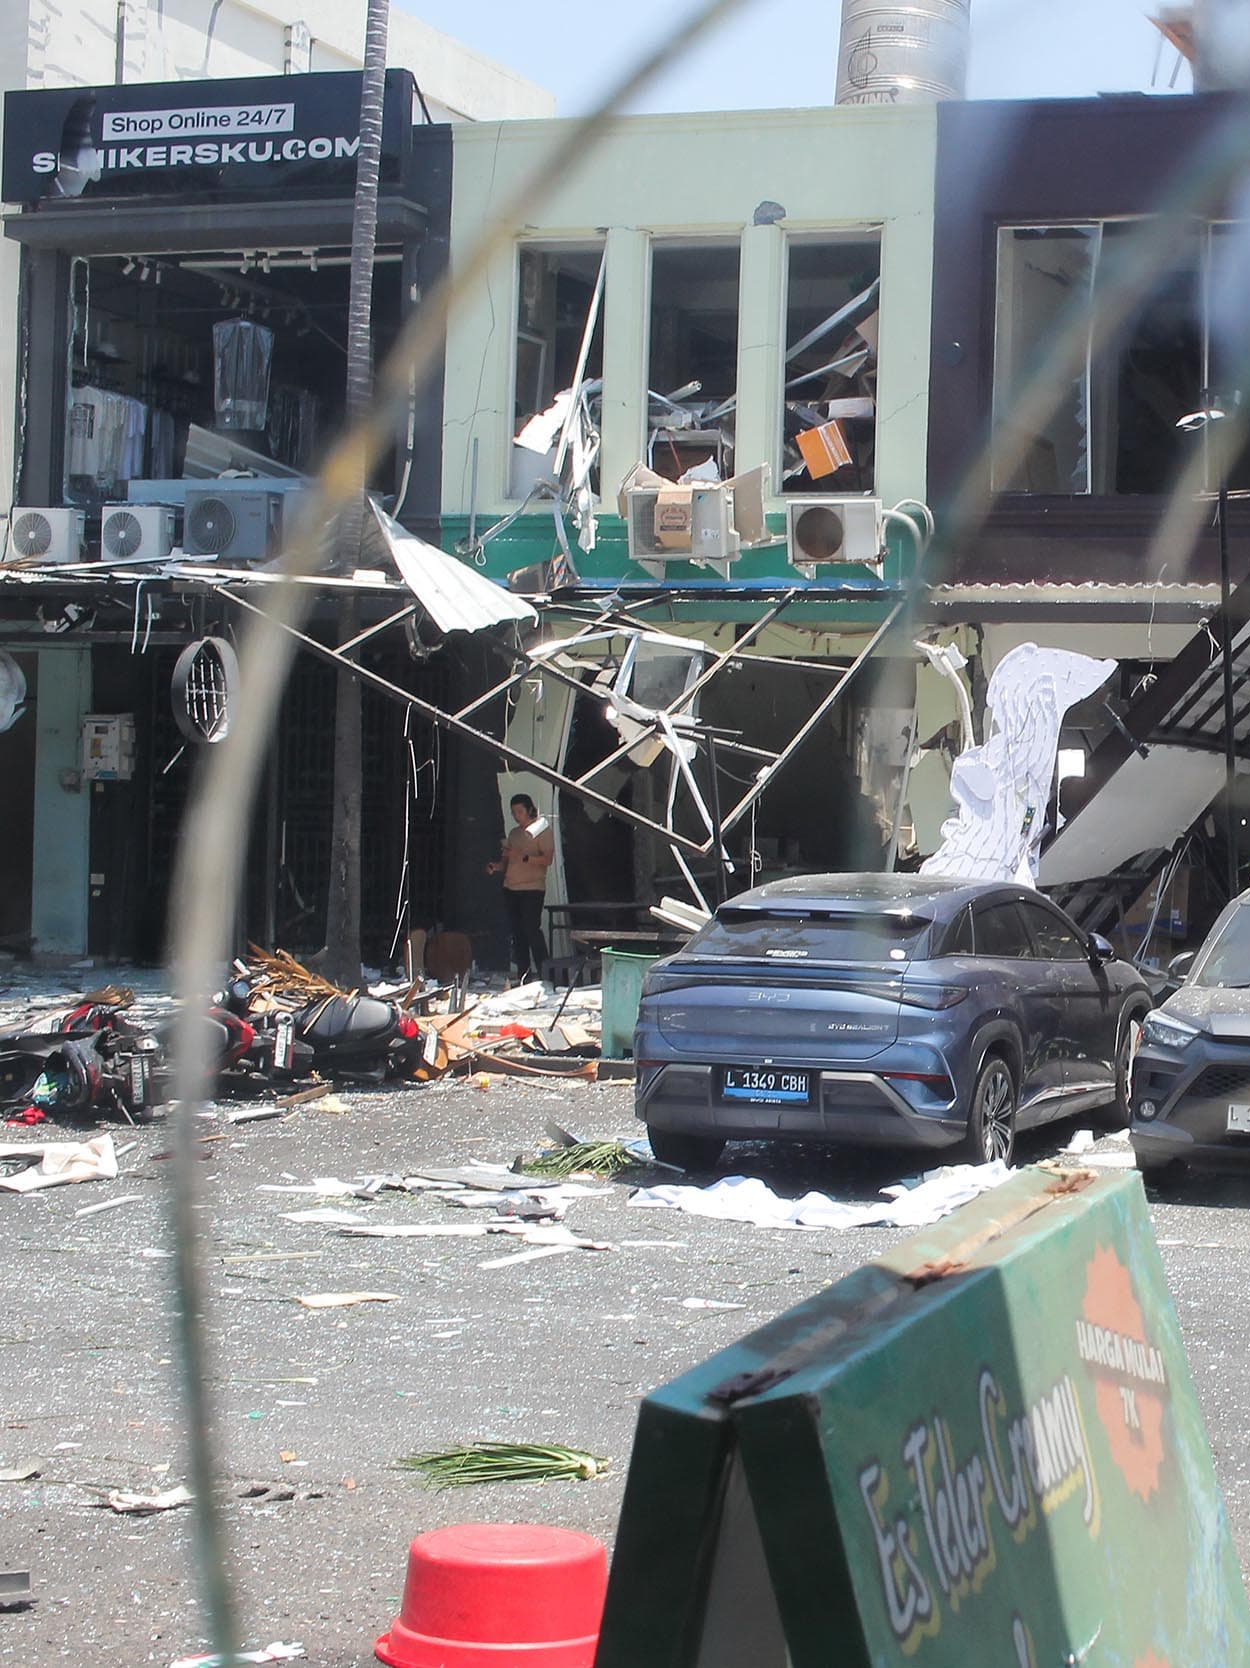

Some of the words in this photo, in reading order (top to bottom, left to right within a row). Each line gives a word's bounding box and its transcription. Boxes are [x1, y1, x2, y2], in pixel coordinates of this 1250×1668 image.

[111, 116, 163, 134] Shop
[168, 112, 231, 130] Online
[236, 108, 287, 127] 24/7
[727, 1071, 735, 1087] L
[743, 1072, 775, 1090] 1349
[781, 1074, 806, 1092] CBH
[1231, 1107, 1238, 1120] L
[1075, 1319, 1126, 1371] HARGA
[1122, 1337, 1166, 1384] MULAI
[1118, 1385, 1140, 1429] 7K
[859, 1462, 932, 1636] Es
[903, 1414, 988, 1595] Teler
